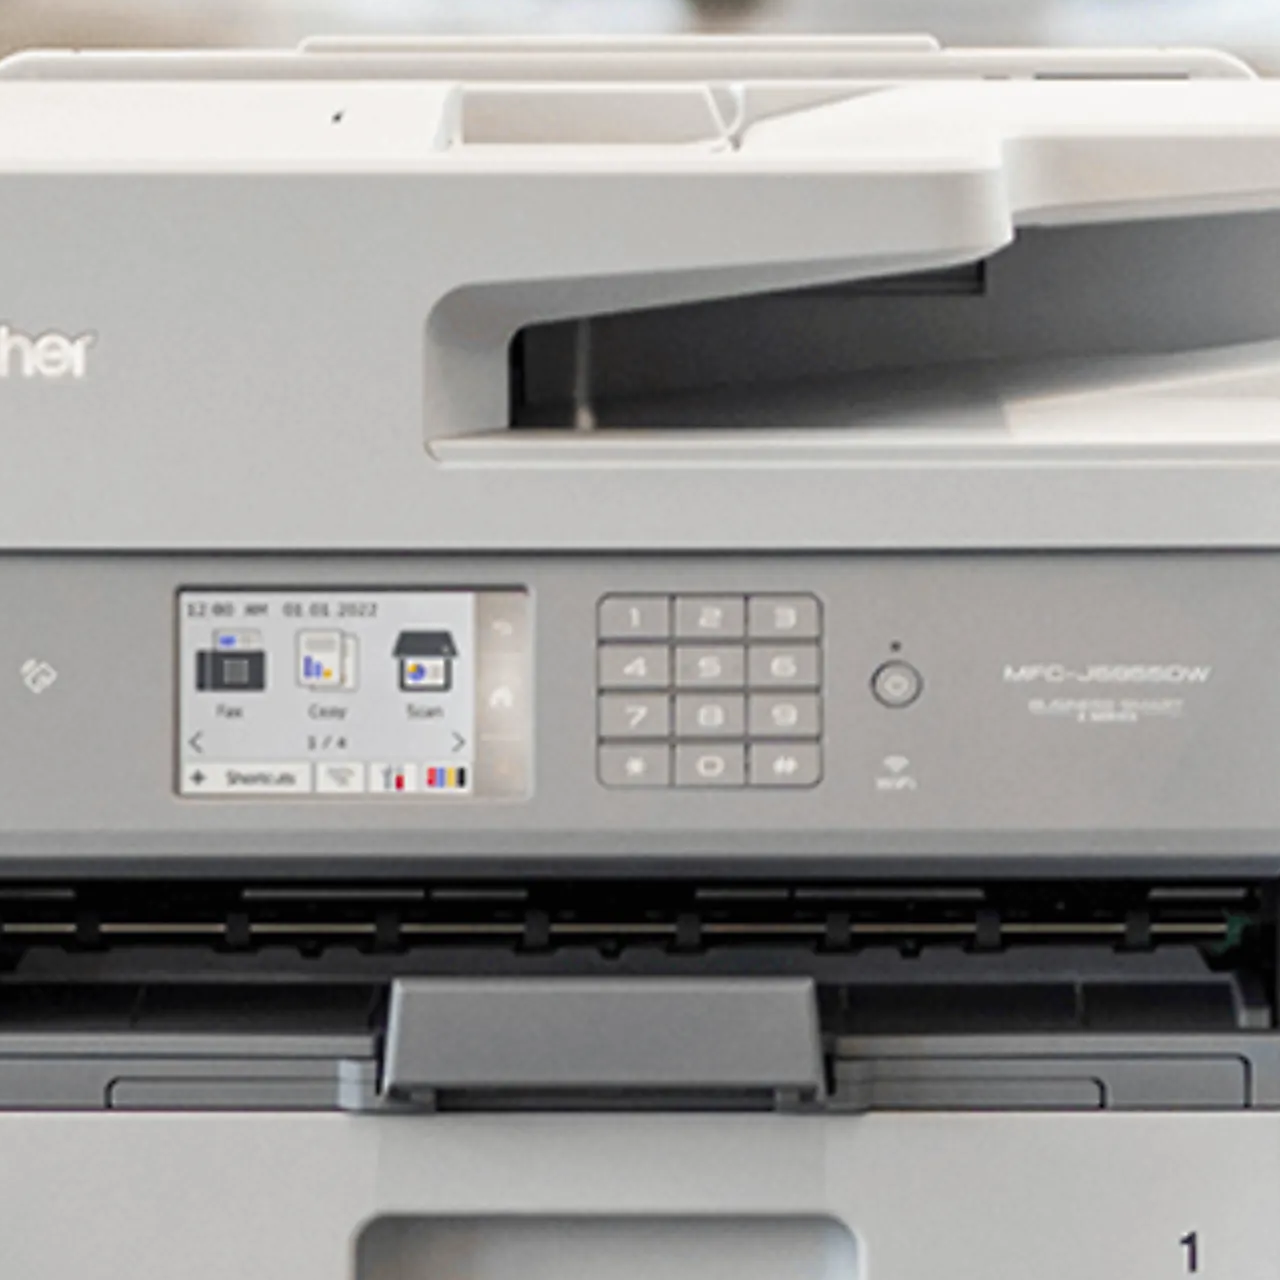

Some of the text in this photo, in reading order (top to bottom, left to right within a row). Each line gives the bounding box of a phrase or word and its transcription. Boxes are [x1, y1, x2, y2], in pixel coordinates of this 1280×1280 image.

[629, 607, 641, 628] 1
[623, 656, 797, 678] 4 5 6
[216, 704, 244, 719] Fax
[307, 703, 348, 721] Copy
[405, 703, 444, 719] Scan
[625, 704, 648, 728] 7
[226, 770, 296, 786] Shortcuts
[1179, 1232, 1198, 1272] 1
